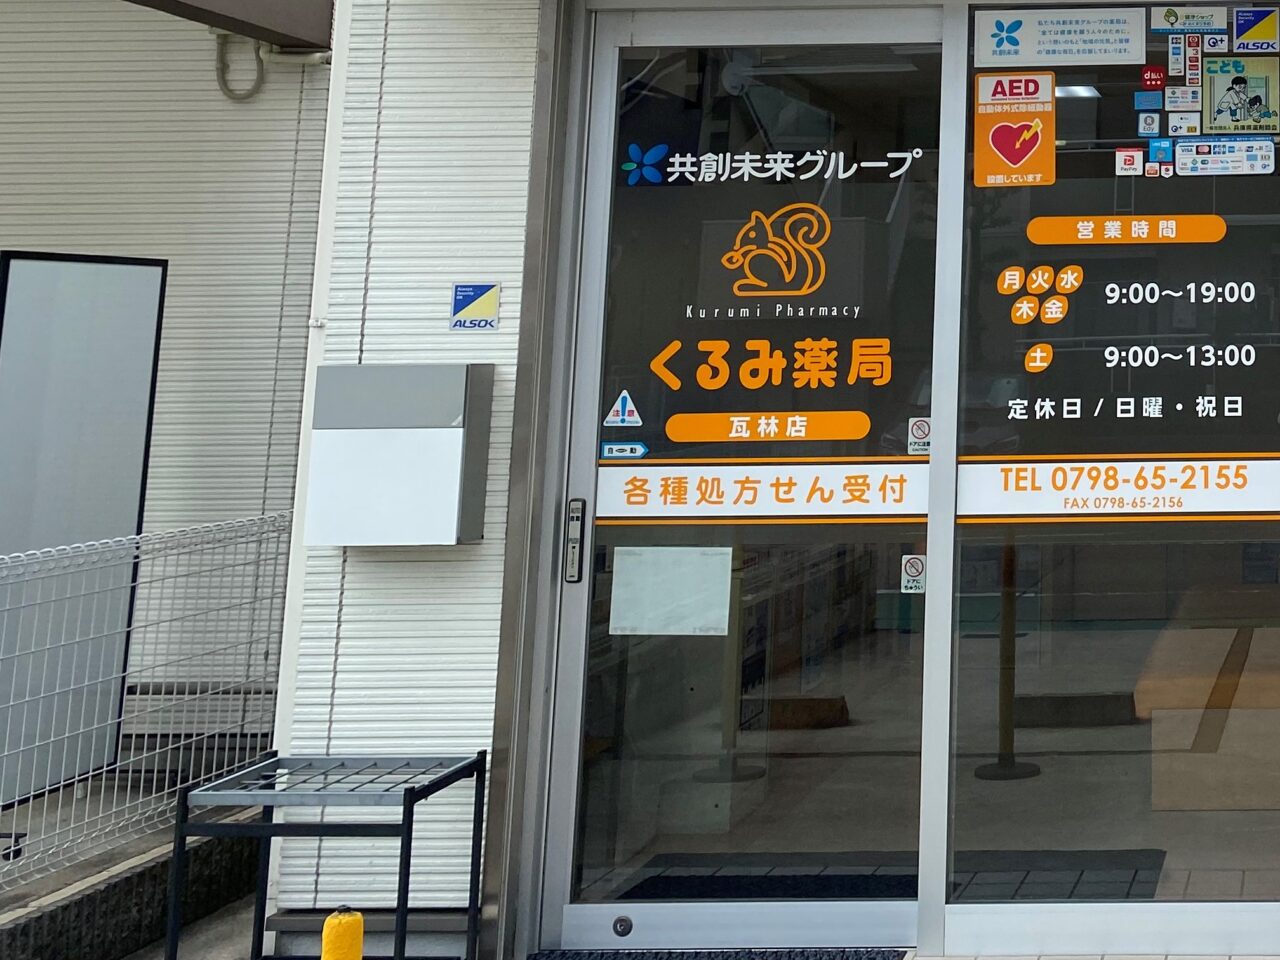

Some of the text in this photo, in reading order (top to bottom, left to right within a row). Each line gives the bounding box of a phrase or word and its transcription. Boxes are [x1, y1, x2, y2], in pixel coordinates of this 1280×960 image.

[1236, 41, 1278, 51] ALSOK
[1206, 59, 1245, 74] こども
[991, 78, 1041, 98] AED
[667, 147, 923, 183] 共創未来グループ
[1076, 220, 1177, 239] 営業時間
[686, 303, 862, 320] Kurumi Pharmacy
[452, 319, 495, 329] ALSOK
[649, 337, 893, 391] くるみ薬局
[1028, 348, 1049, 368] 土
[728, 414, 809, 438] 瓦林店
[1000, 464, 1249, 492] TEL 0798-65-2155
[623, 472, 909, 507] 各種処方せん受付
[1063, 496, 1184, 509] FAX 0798-65-2156
